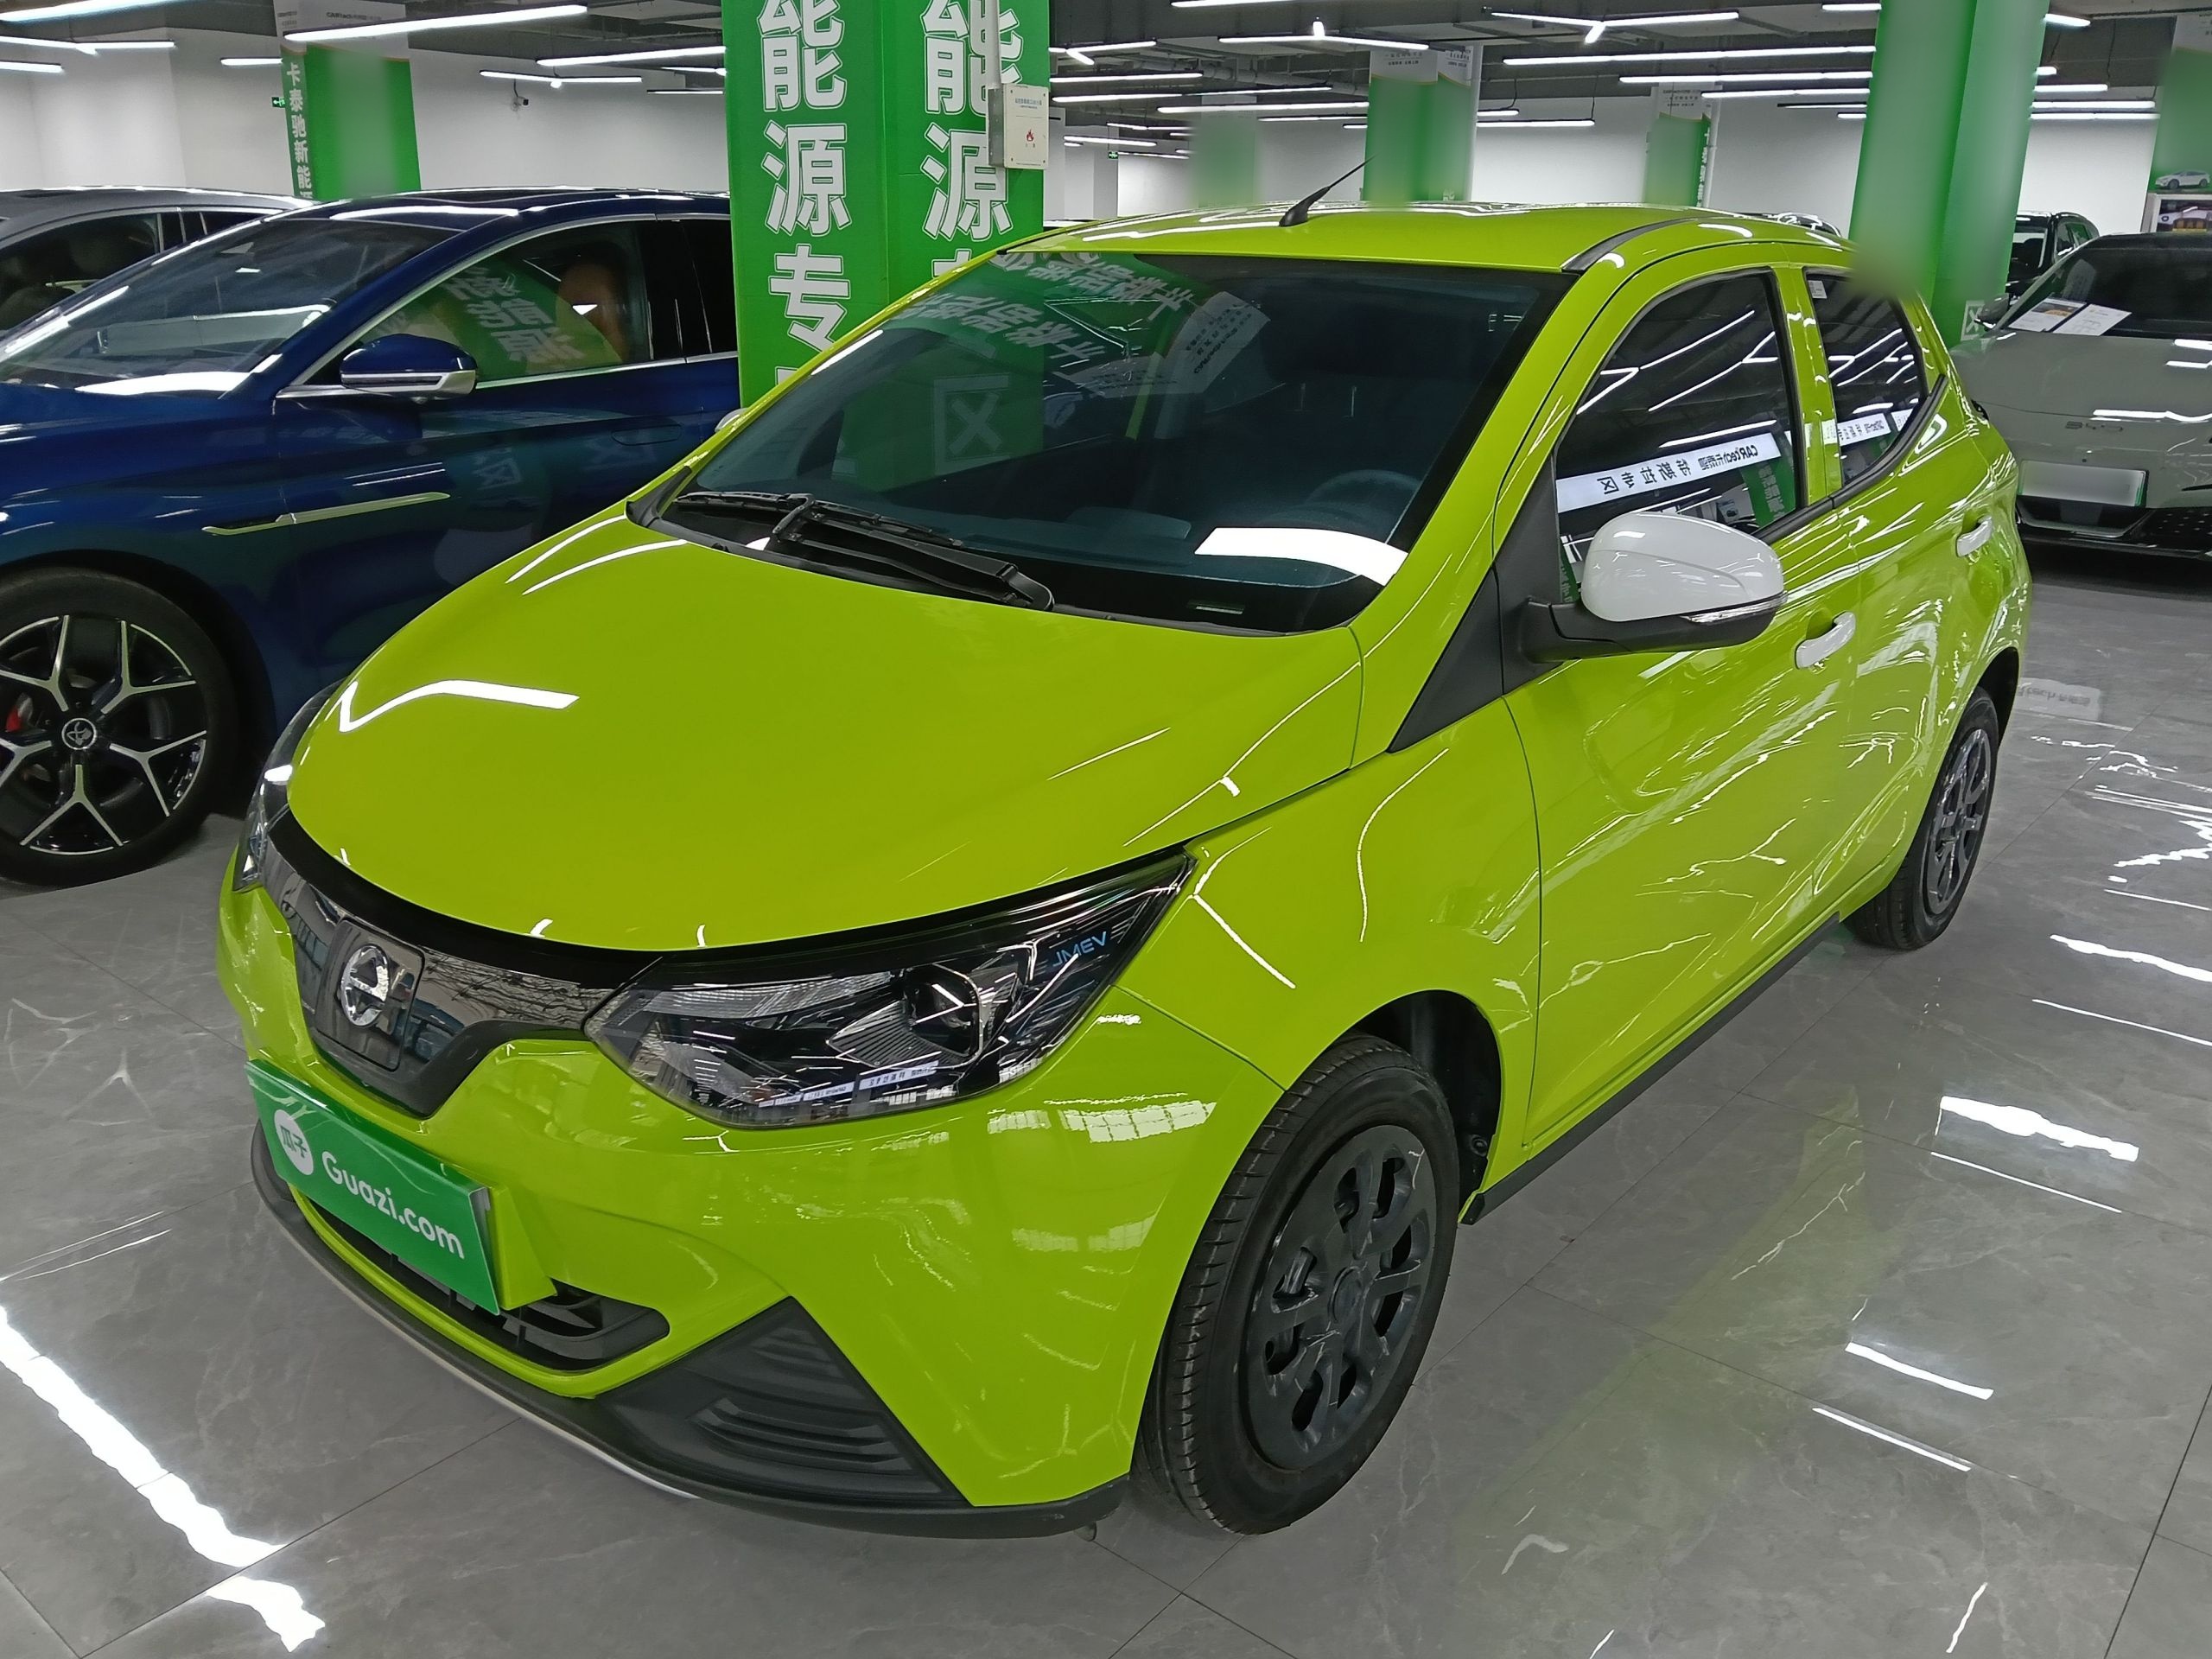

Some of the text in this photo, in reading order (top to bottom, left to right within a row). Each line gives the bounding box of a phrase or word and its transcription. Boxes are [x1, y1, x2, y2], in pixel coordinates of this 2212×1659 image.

[286, 62, 313, 199] 卡泰驰新能
[757, 0, 851, 385] 能源专
[921, 0, 1022, 276] 能源
[1052, 931, 1107, 967] JMEV
[321, 1150, 465, 1259] Guazi.com
